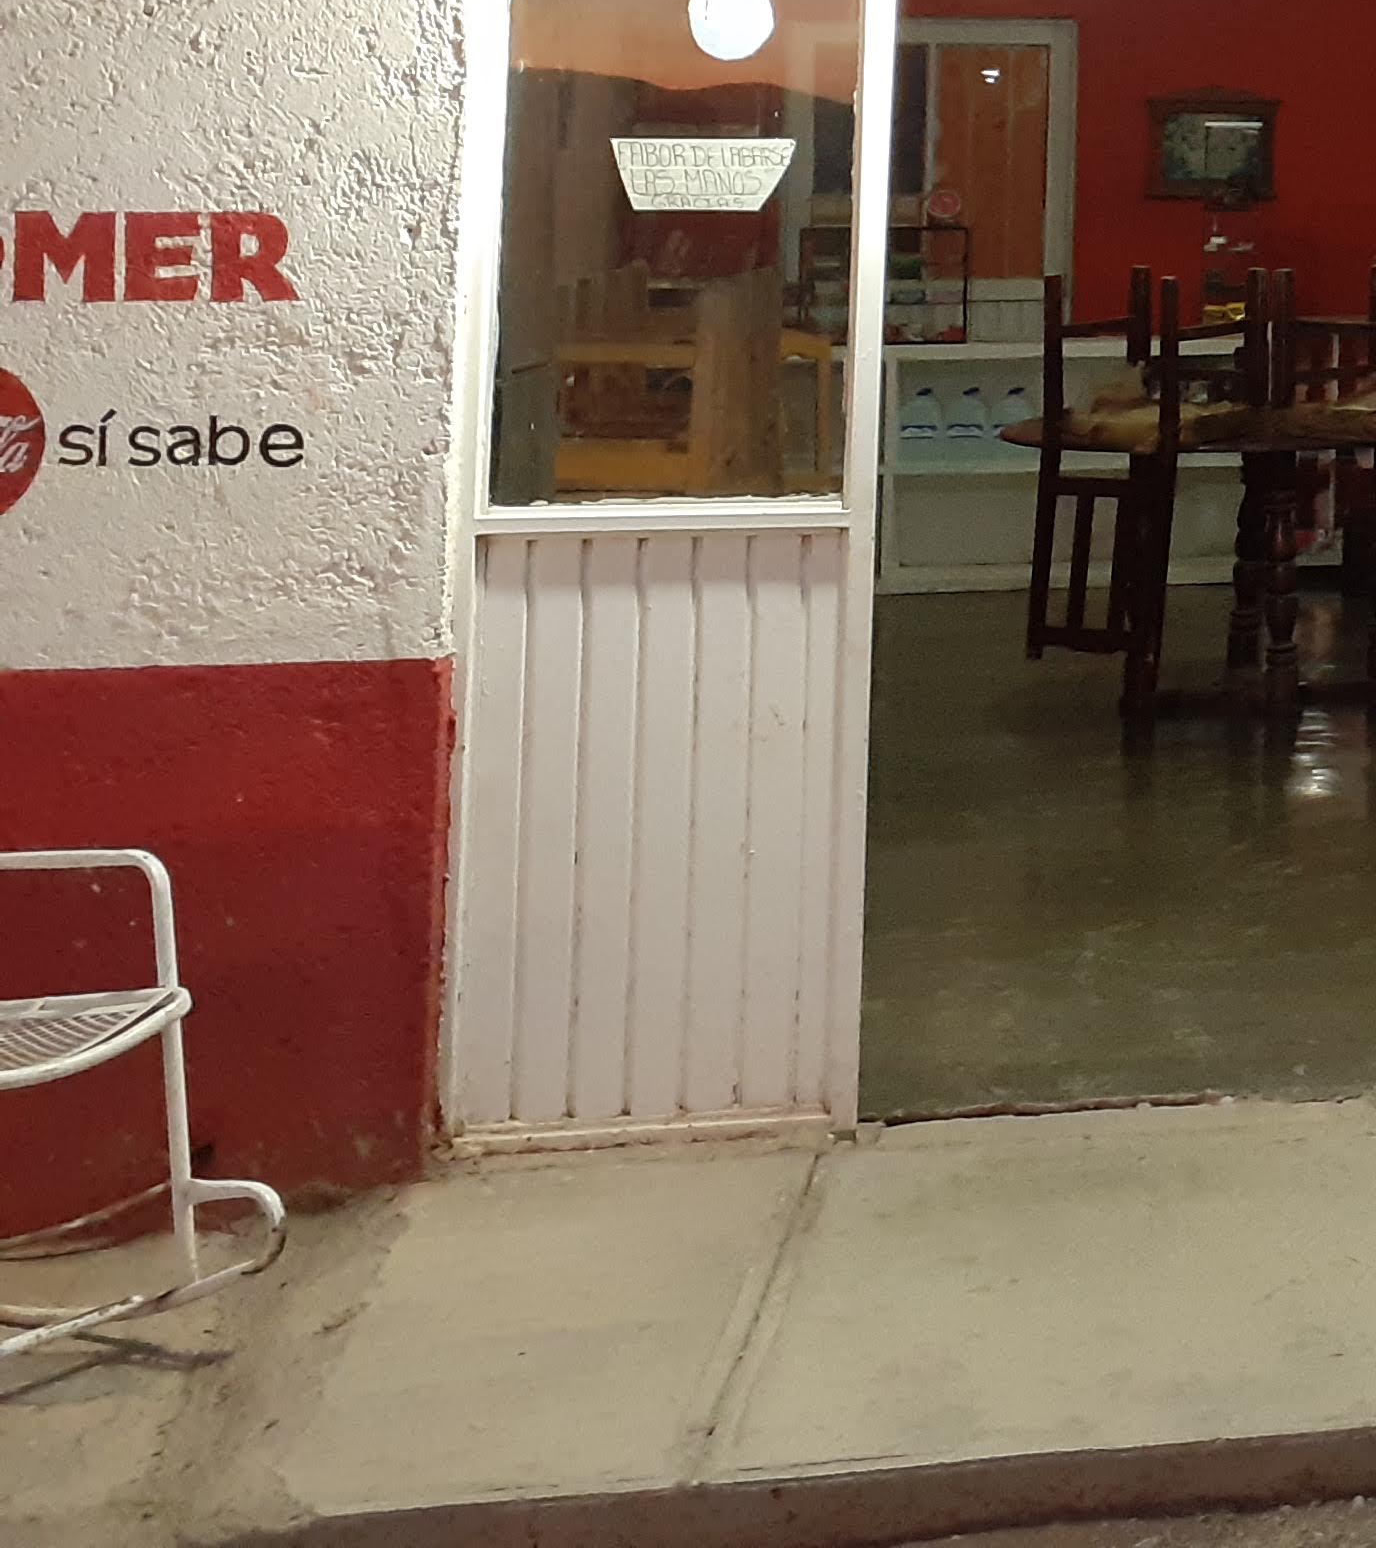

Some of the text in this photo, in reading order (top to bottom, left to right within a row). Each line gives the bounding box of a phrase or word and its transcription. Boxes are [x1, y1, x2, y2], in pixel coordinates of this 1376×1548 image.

[650, 196, 744, 209] GRACIAS
[0, 210, 301, 302] MER
[58, 409, 117, 467] sí
[128, 415, 304, 468] sabe
